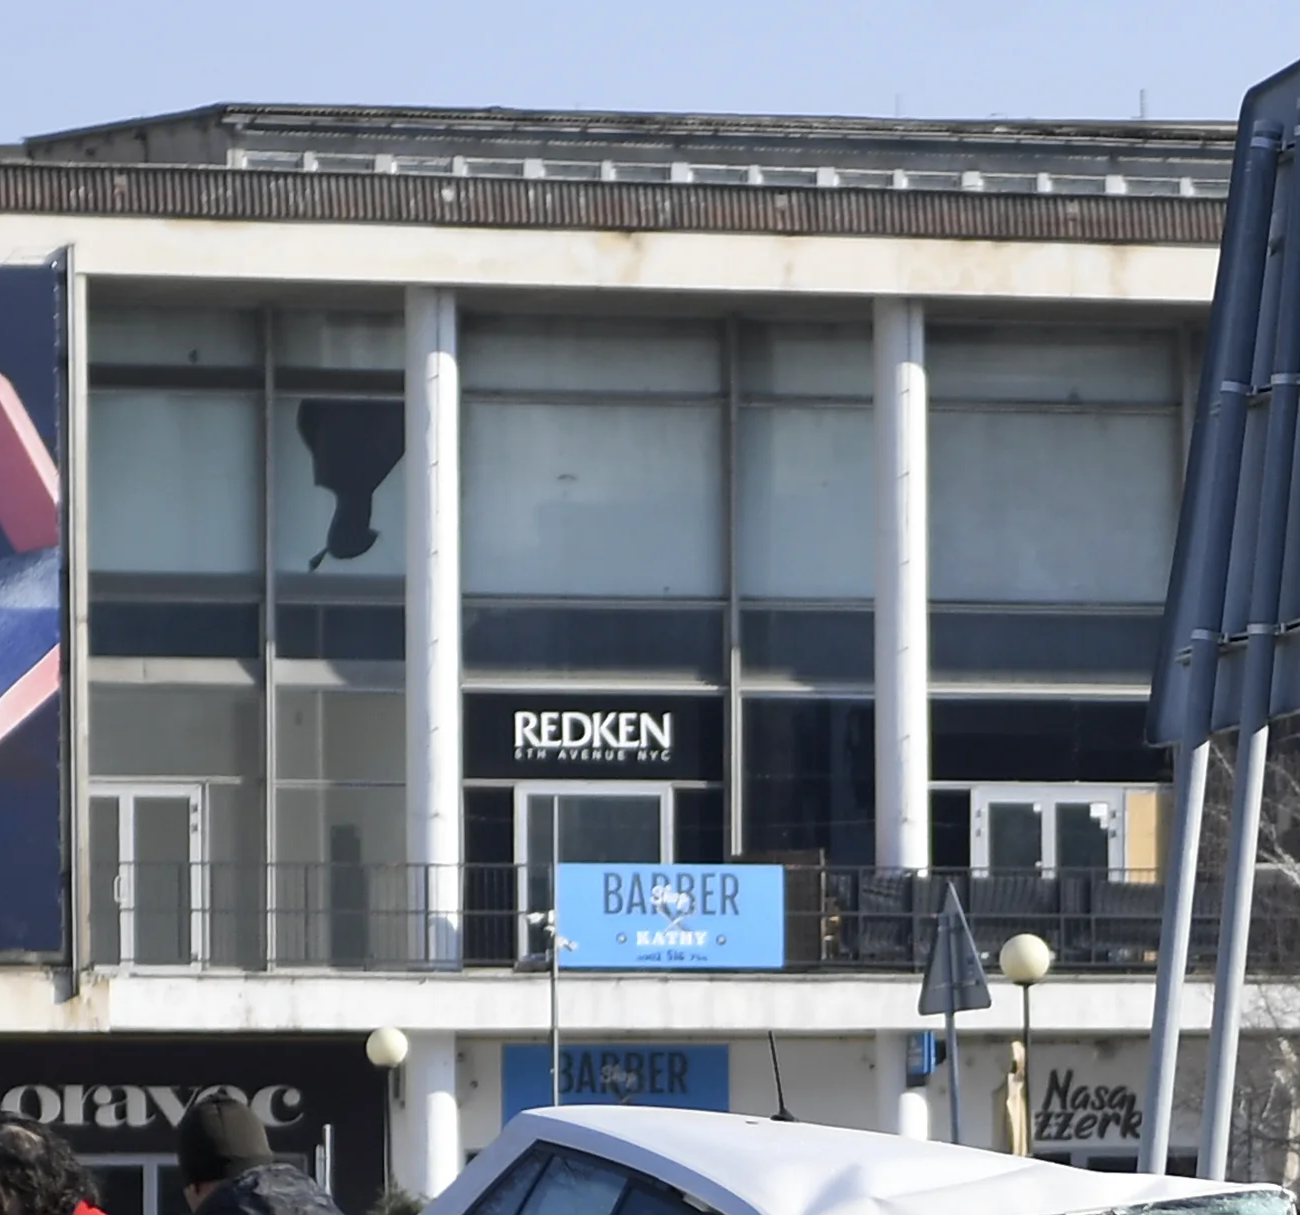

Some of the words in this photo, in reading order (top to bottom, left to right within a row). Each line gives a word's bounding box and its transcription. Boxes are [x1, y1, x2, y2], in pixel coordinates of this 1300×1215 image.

[514, 711, 672, 748] REDKEN
[557, 748, 626, 761] AVENUE
[637, 749, 672, 761] NYC
[603, 872, 739, 916] BARBER
[636, 930, 709, 947] KATHY
[557, 1052, 689, 1094] BARBER
[1, 1084, 304, 1128] oravc
